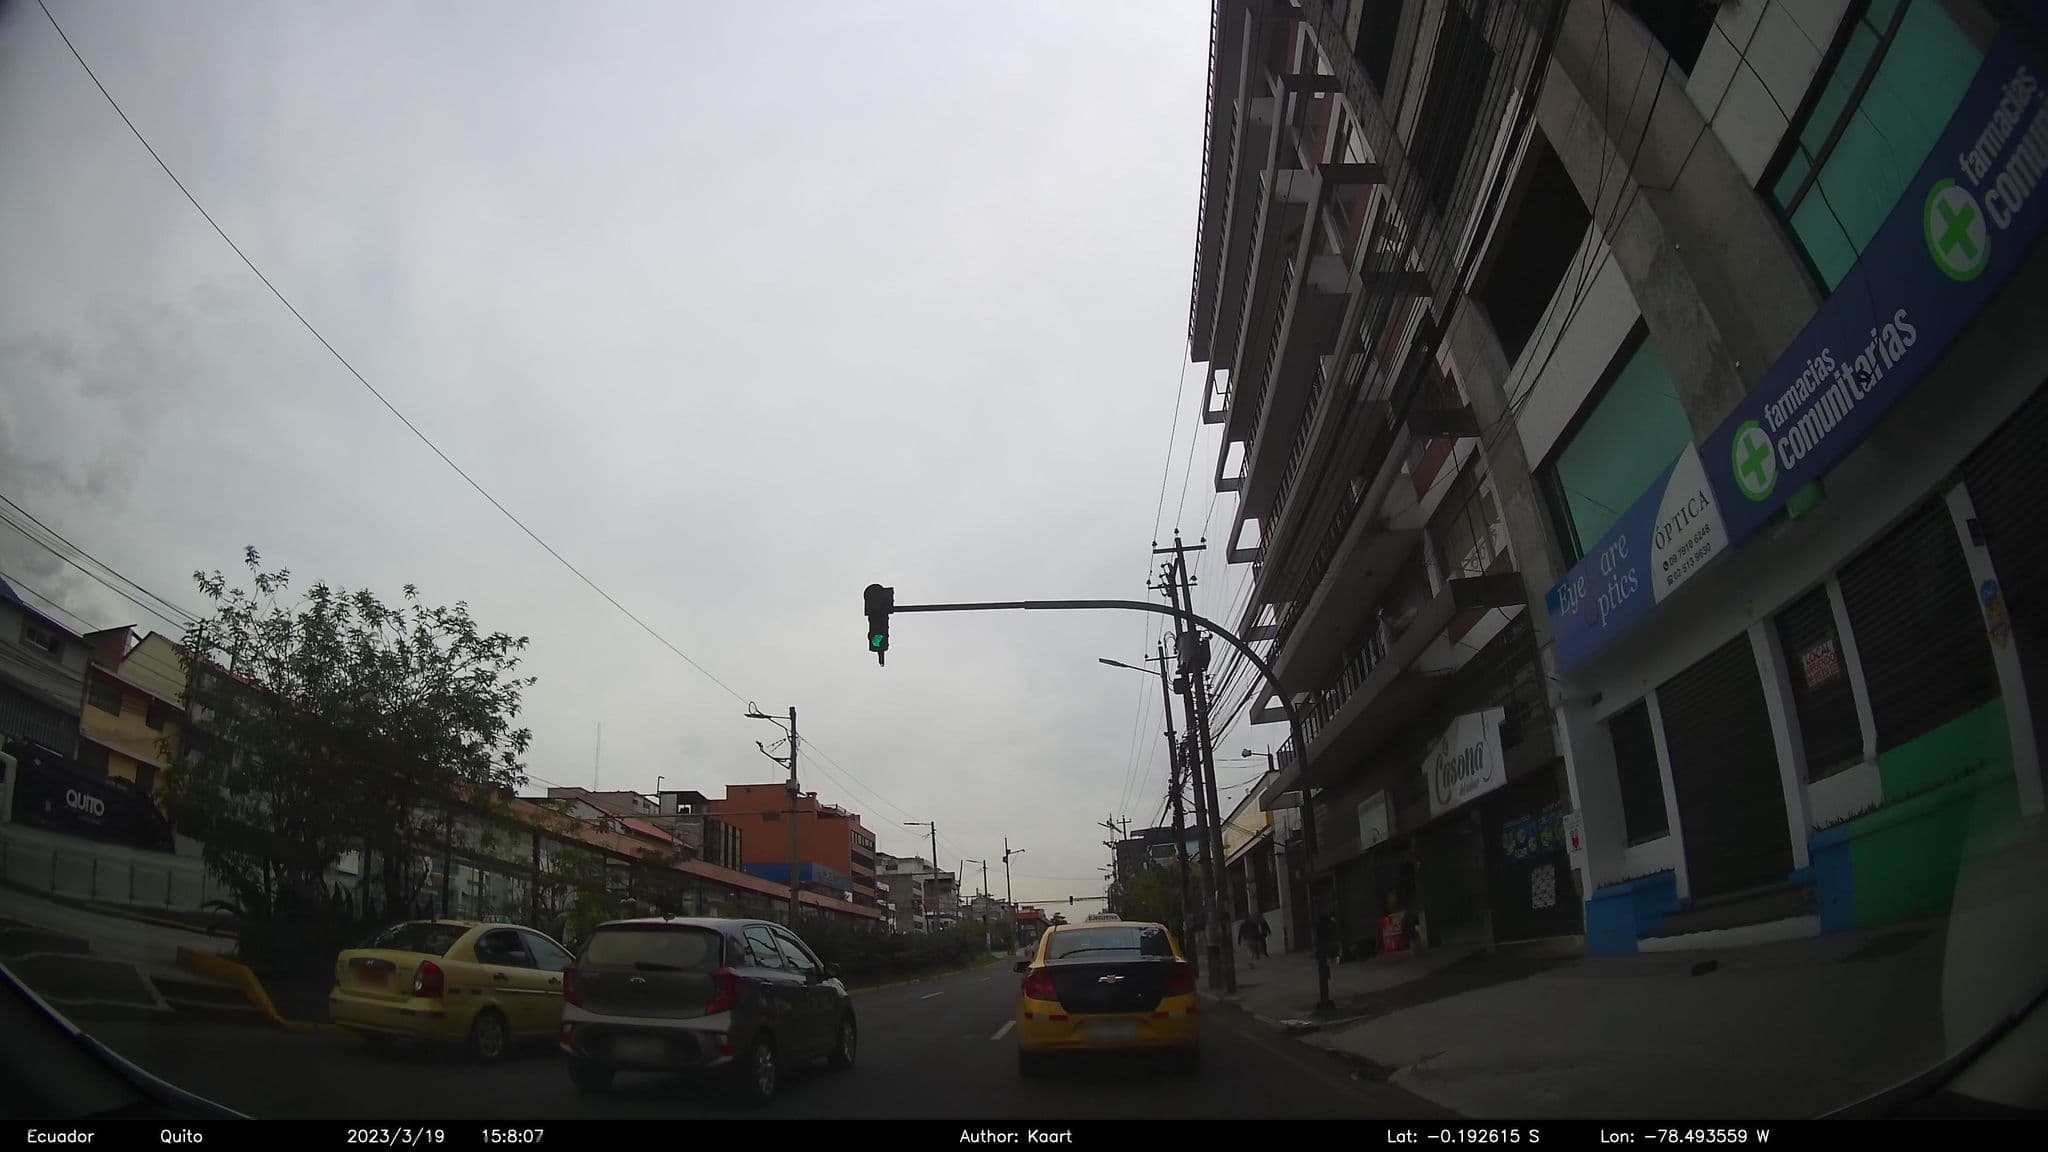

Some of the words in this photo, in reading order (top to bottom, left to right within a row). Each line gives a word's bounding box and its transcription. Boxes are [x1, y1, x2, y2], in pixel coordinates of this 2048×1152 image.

[1959, 64, 2038, 187] farmacias
[1764, 347, 1836, 433] farmacias
[1777, 308, 1918, 471] comunitarias
[1655, 490, 1710, 551] ÓPTICA
[1679, 539, 1695, 559] 7910
[1682, 557, 1695, 573] 513
[1557, 576, 1586, 616] Eye
[66, 789, 105, 816] QUITO
[1436, 741, 1485, 805] Casona
